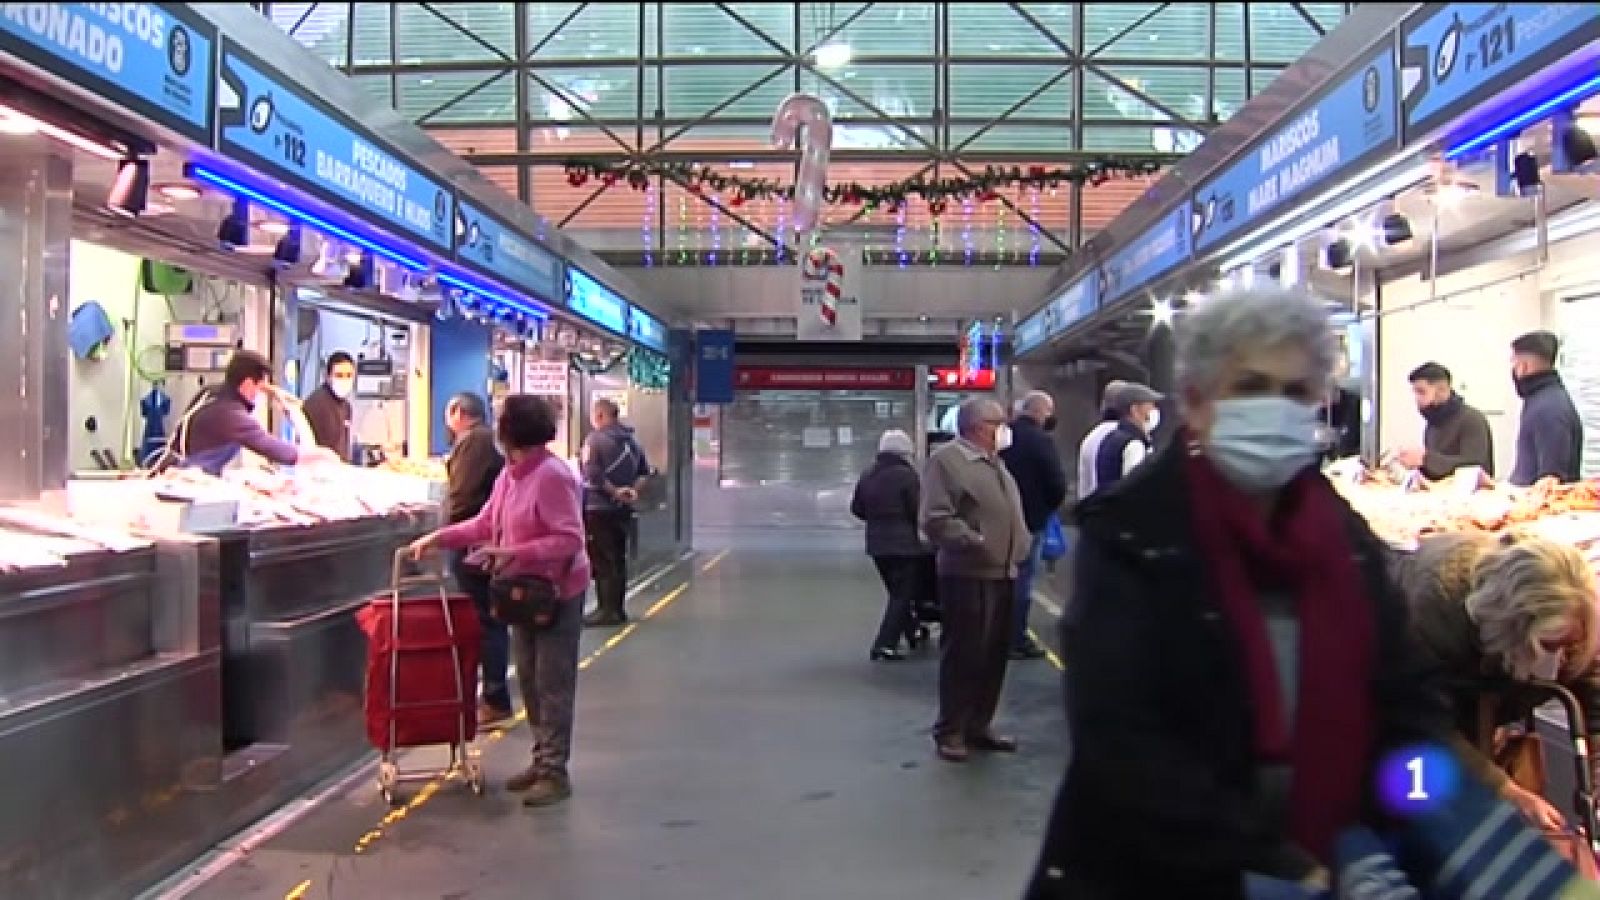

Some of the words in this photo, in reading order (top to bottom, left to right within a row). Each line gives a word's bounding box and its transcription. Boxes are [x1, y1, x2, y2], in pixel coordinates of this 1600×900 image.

[1480, 15, 1515, 69] 121
[284, 132, 306, 168] 112
[352, 139, 406, 193] PESCADOS
